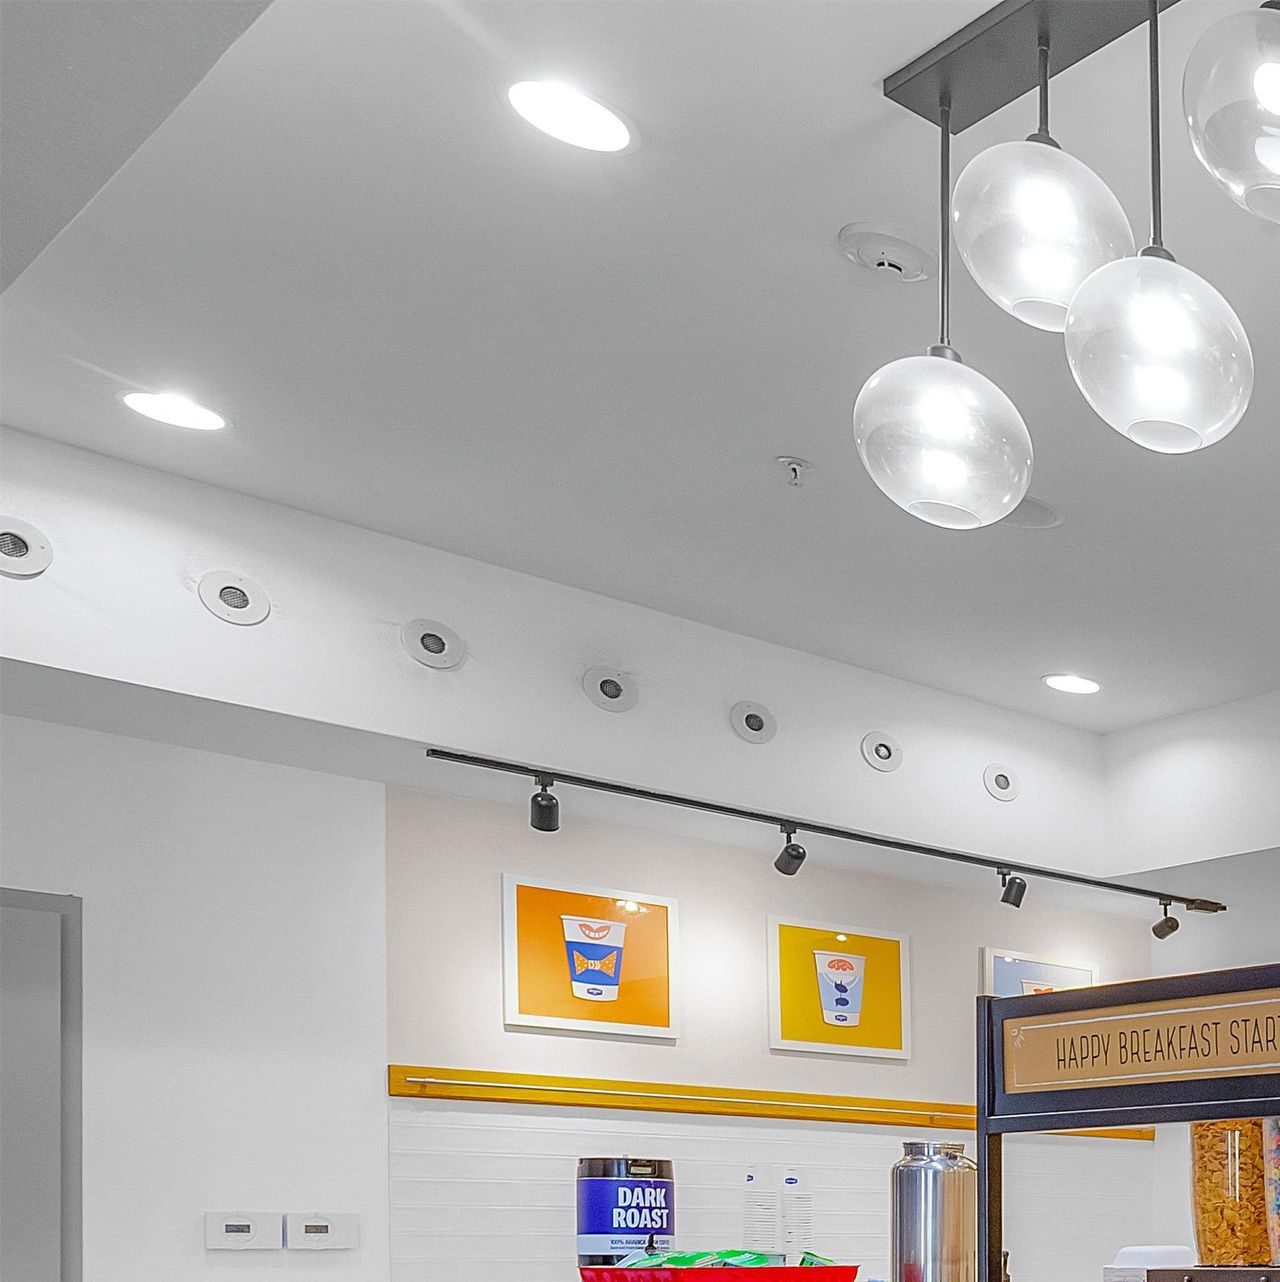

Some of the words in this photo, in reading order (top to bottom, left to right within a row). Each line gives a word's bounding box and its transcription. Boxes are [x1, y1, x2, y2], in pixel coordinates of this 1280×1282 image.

[1056, 1033, 1111, 1071] HAPPY
[1119, 1021, 1222, 1065] BREAKFAST
[618, 1186, 667, 1208] DARK
[612, 1207, 670, 1229] ROAST
